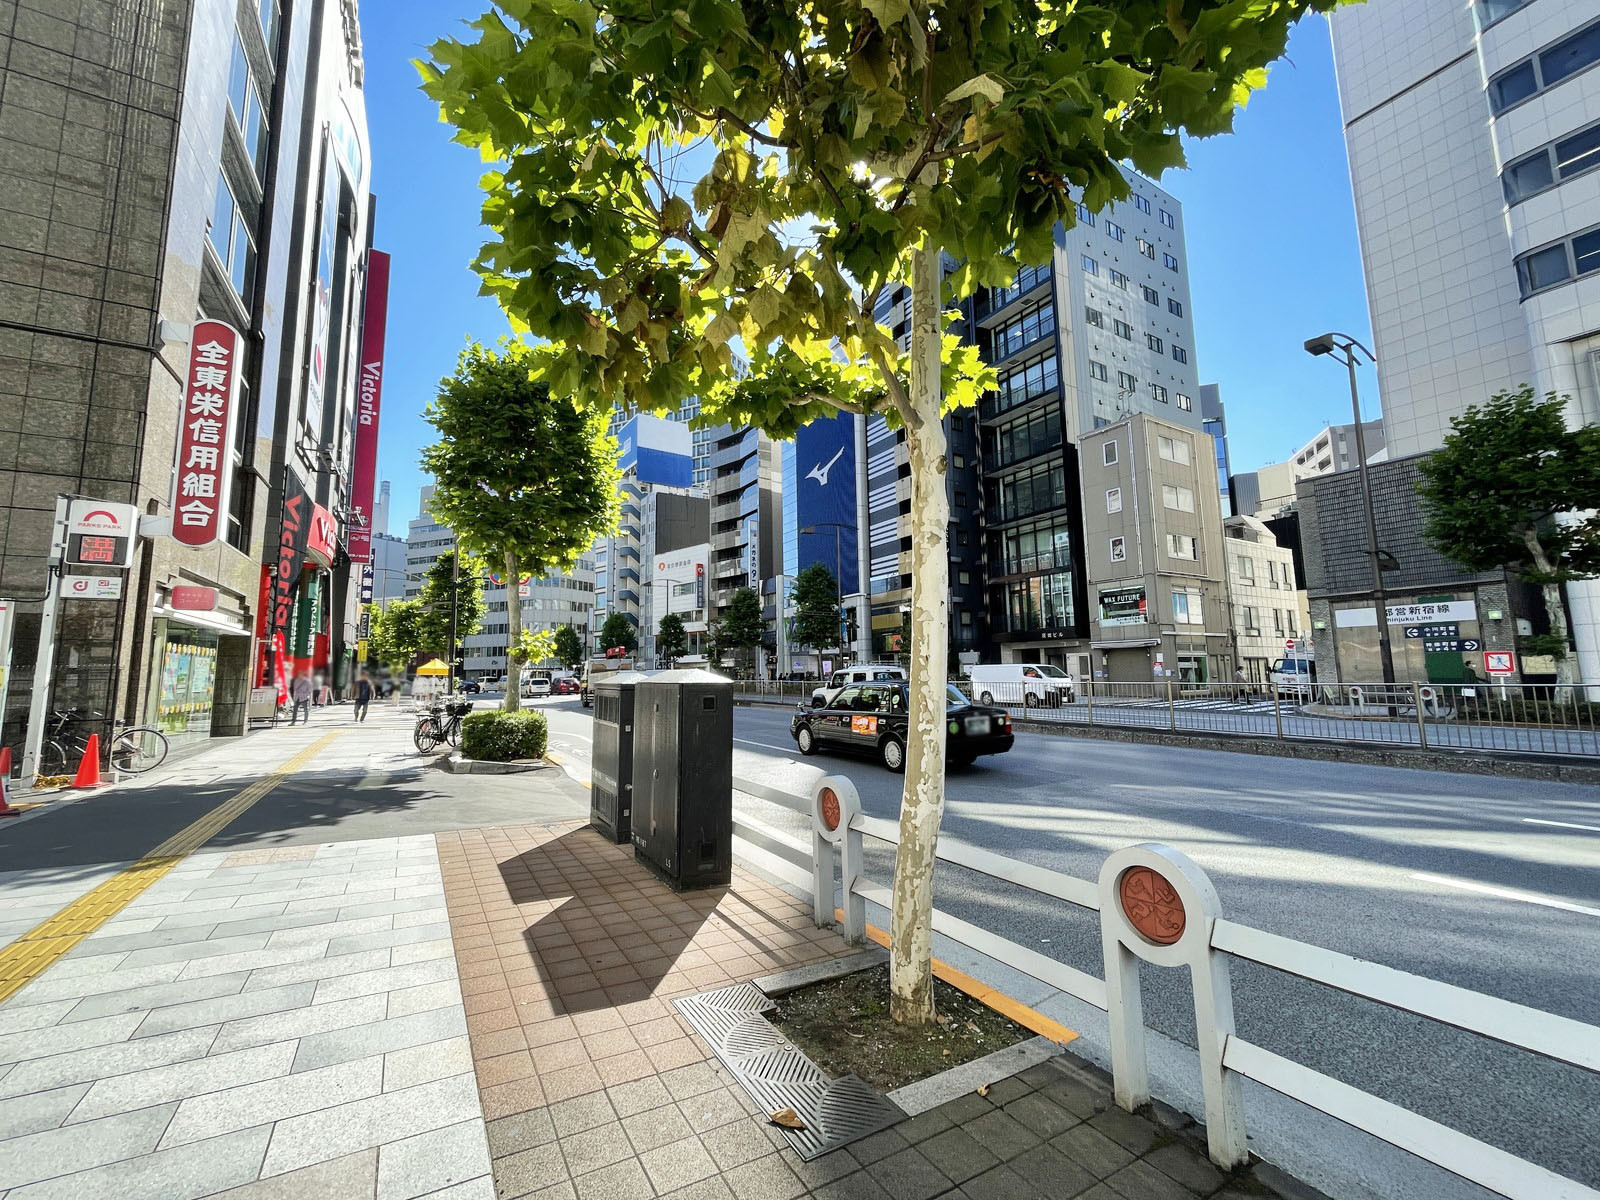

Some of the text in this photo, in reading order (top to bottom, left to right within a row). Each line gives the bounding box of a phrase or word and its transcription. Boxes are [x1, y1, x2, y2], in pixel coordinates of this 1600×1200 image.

[360, 361, 381, 425] Victoria
[179, 340, 230, 527] 全東栄信用組合
[80, 536, 116, 562] 満
[275, 494, 303, 627] Victoria
[1117, 593, 1141, 602] FUTURE
